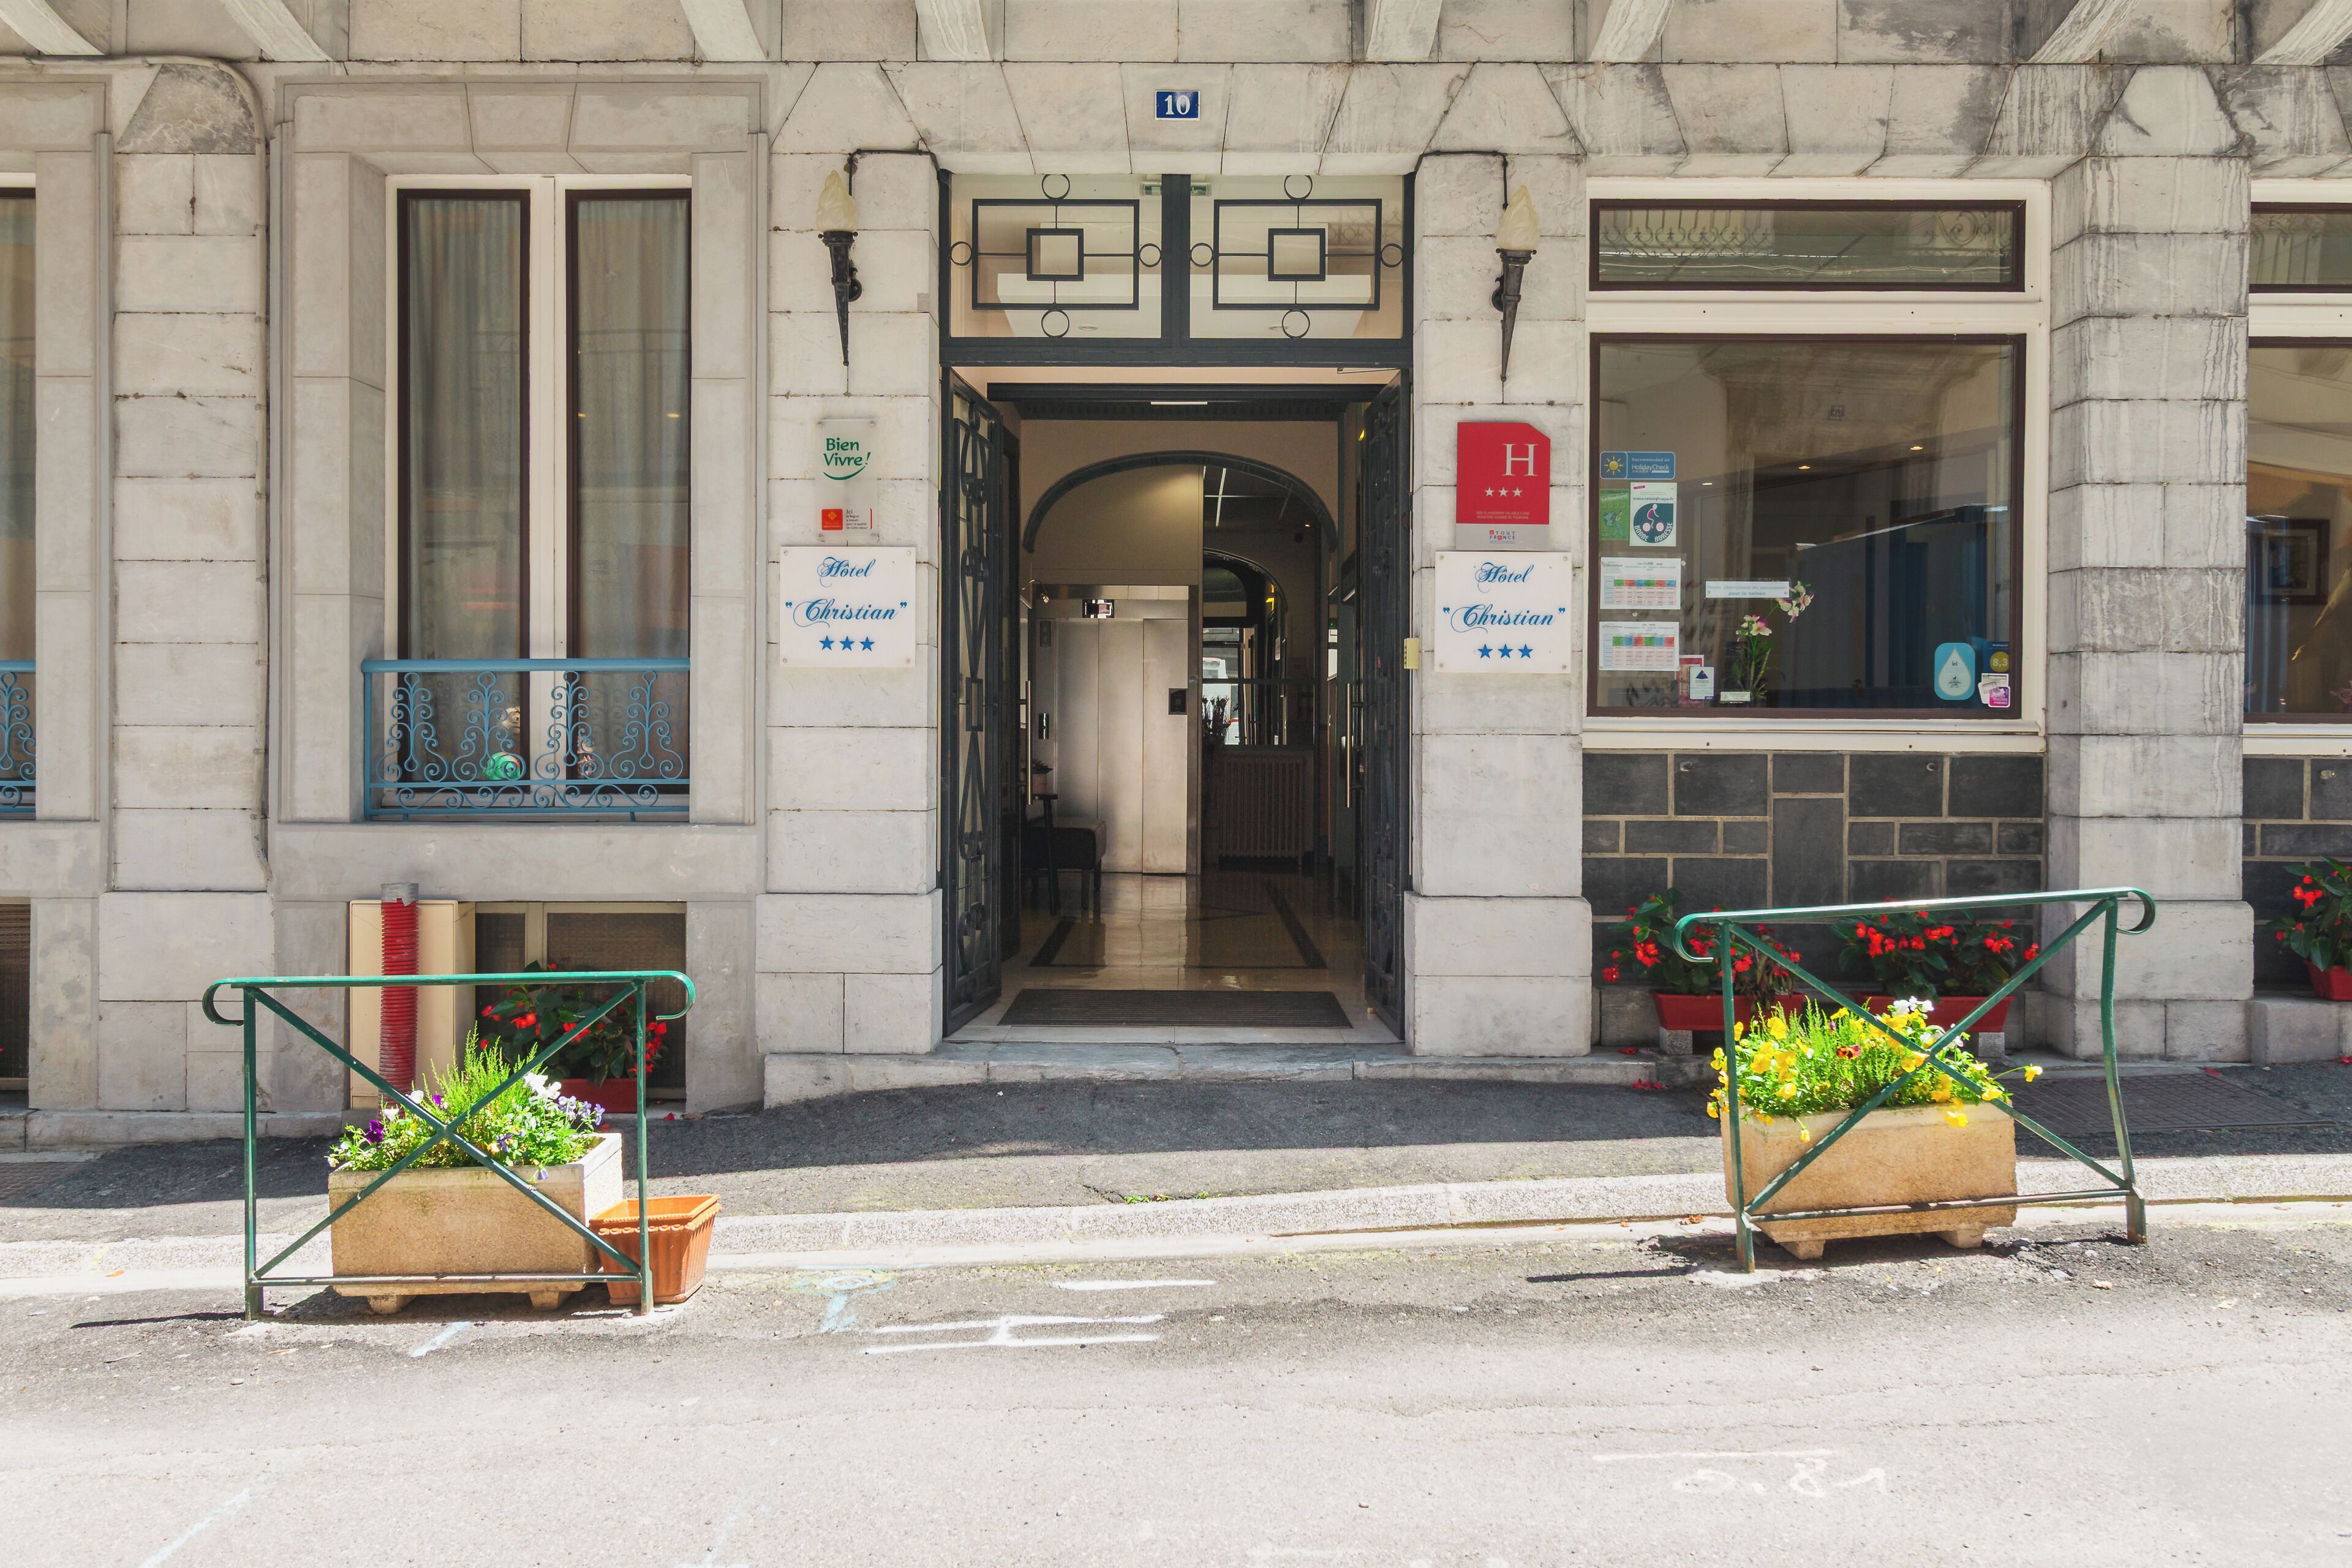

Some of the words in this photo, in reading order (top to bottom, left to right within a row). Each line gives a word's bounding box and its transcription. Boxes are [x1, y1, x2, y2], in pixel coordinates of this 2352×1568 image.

[1164, 95, 1190, 115] 10
[826, 438, 859, 451] Bien
[1502, 443, 1538, 476] H
[1634, 525, 1649, 541] BONNE
[1654, 522, 1673, 542] ADRESSE
[816, 556, 876, 587] Hôtel
[1475, 562, 1534, 593] Hôtel
[1992, 658, 2008, 668] 8,3
